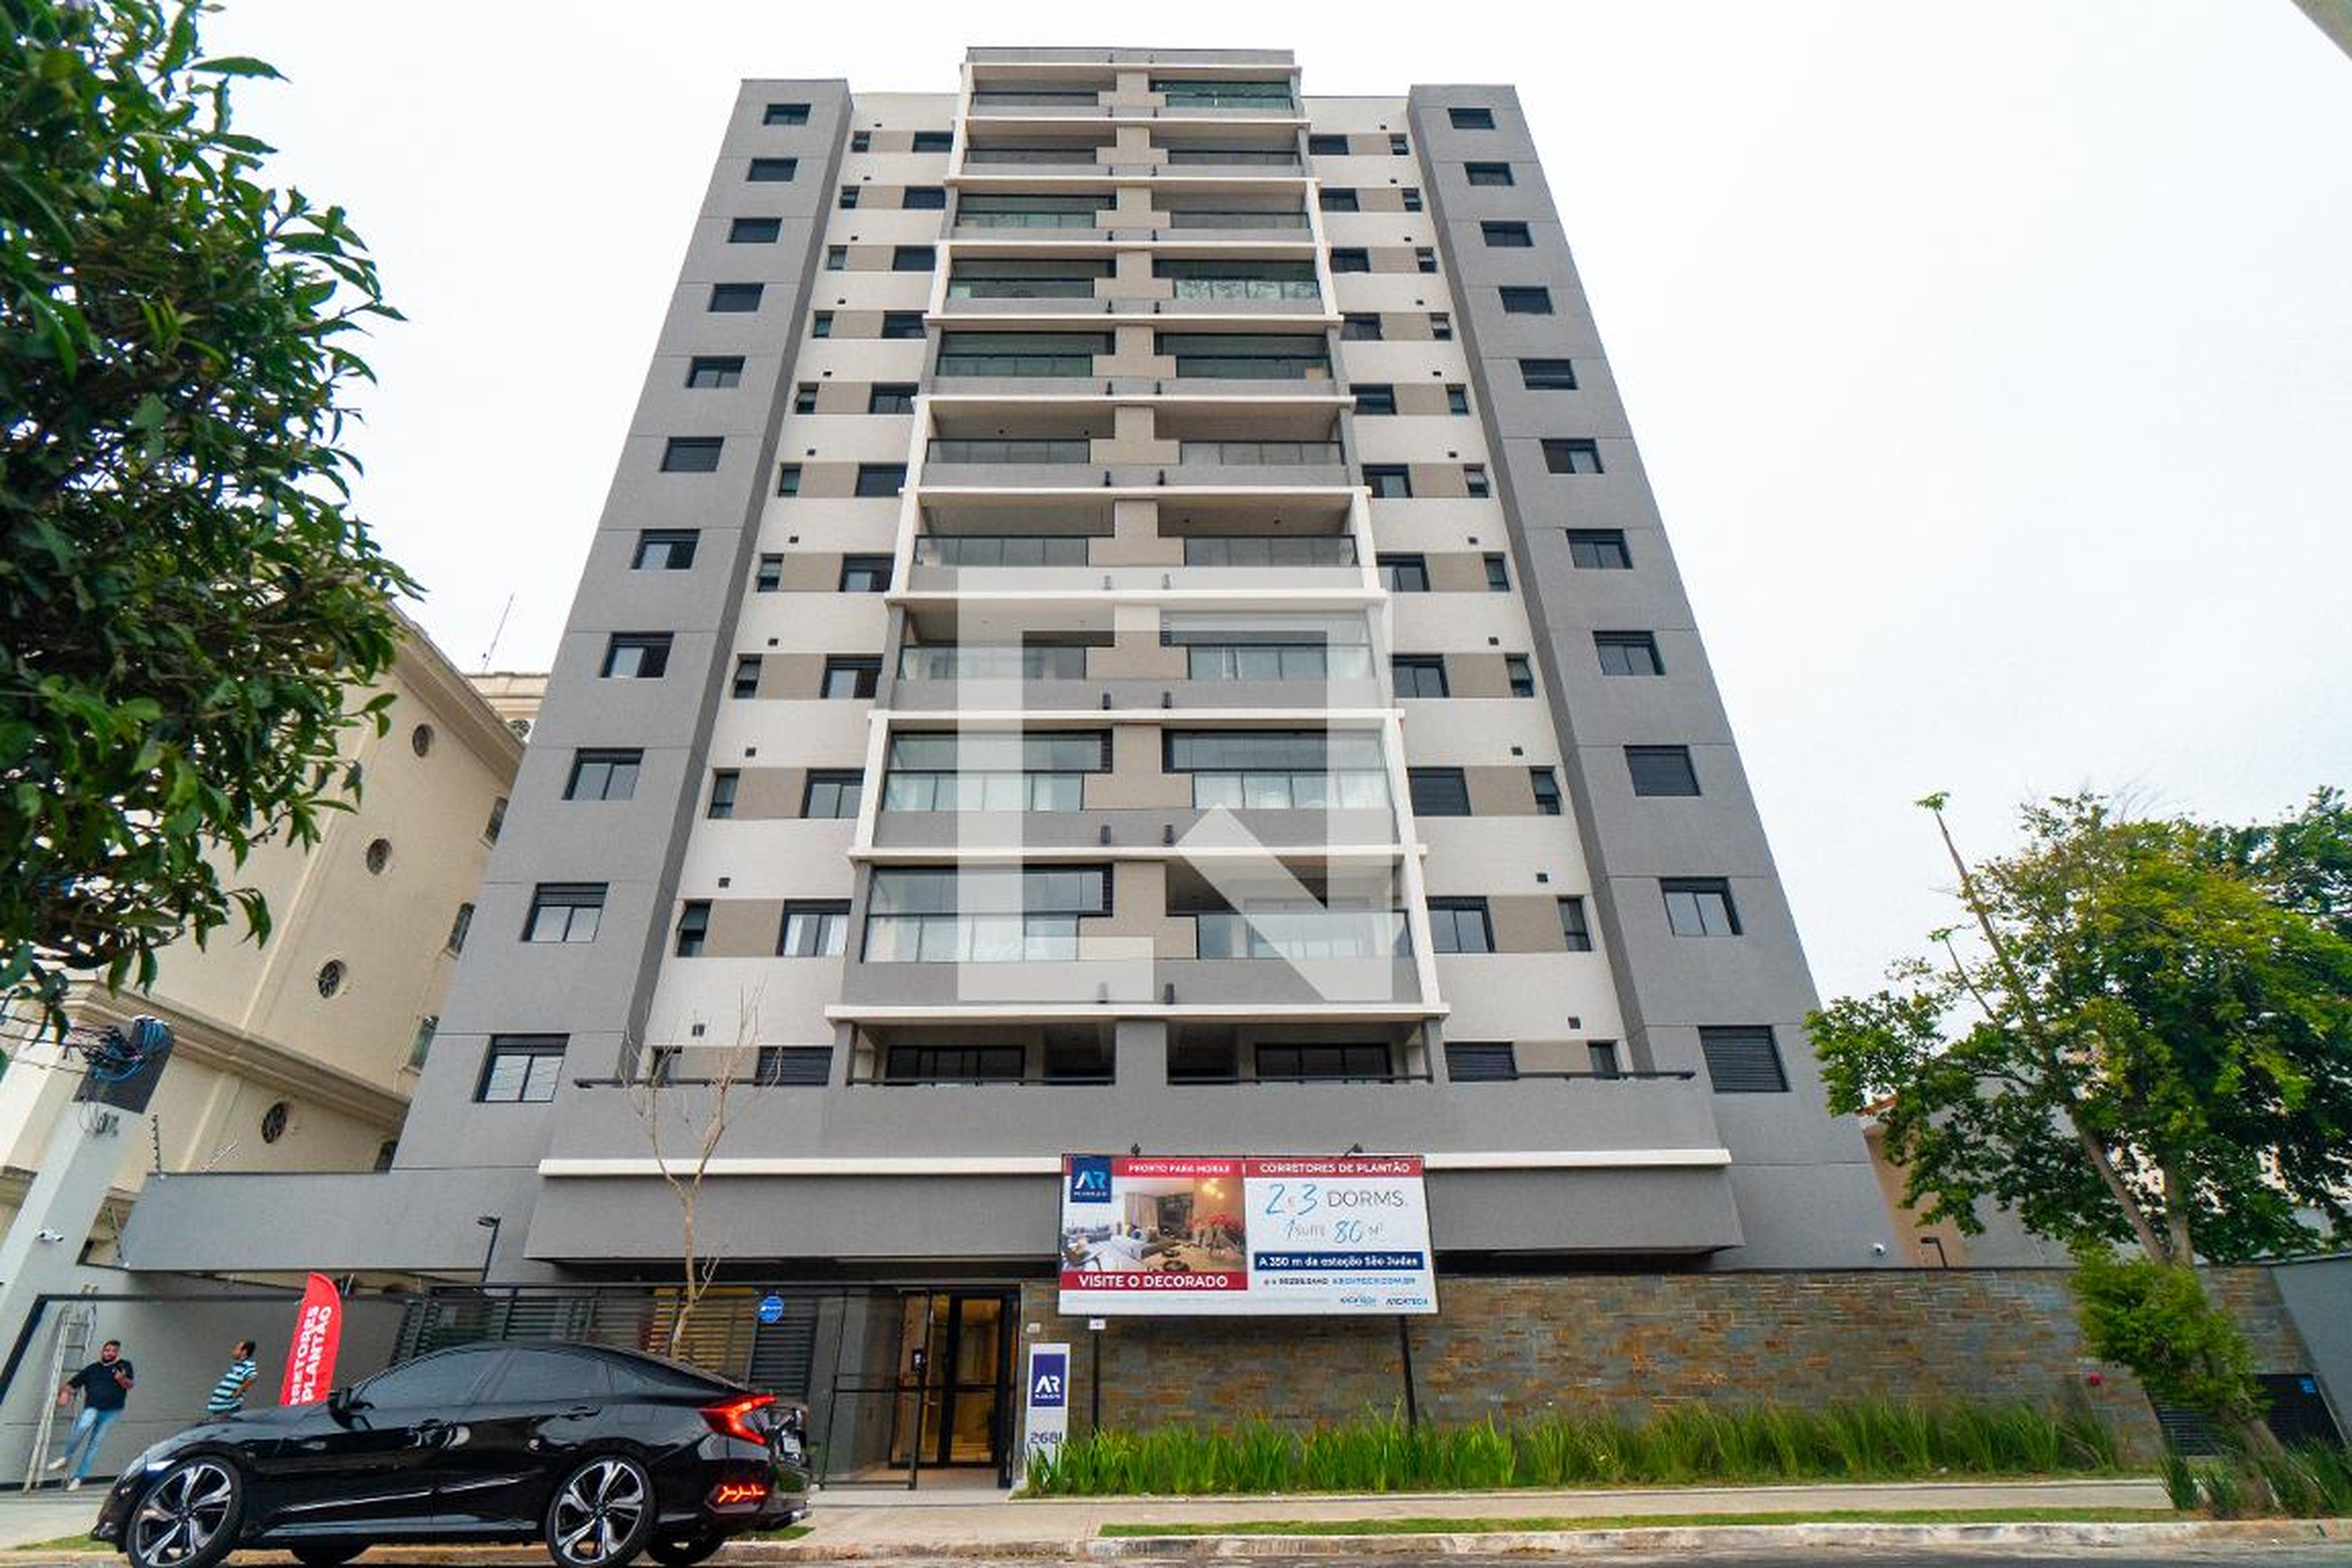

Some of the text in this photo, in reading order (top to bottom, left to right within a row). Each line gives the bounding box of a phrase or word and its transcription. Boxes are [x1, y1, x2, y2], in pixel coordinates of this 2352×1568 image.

[1128, 1164, 1168, 1173] PRONTO
[1169, 1164, 1195, 1173] PARA
[1259, 1161, 1410, 1172] CORRETORES DE PLANTÃO
[1075, 1170, 1106, 1189] AR
[1265, 1183, 1286, 1215] 2
[1297, 1183, 1318, 1215] 3
[1259, 1256, 1268, 1266] A
[1305, 1256, 1318, 1266] da
[1321, 1256, 1363, 1268] estação
[1365, 1256, 1385, 1266] São
[1387, 1256, 1418, 1266] Judas
[1079, 1275, 1228, 1287] VISITE O DECORADO
[1035, 1375, 1060, 1392] AR
